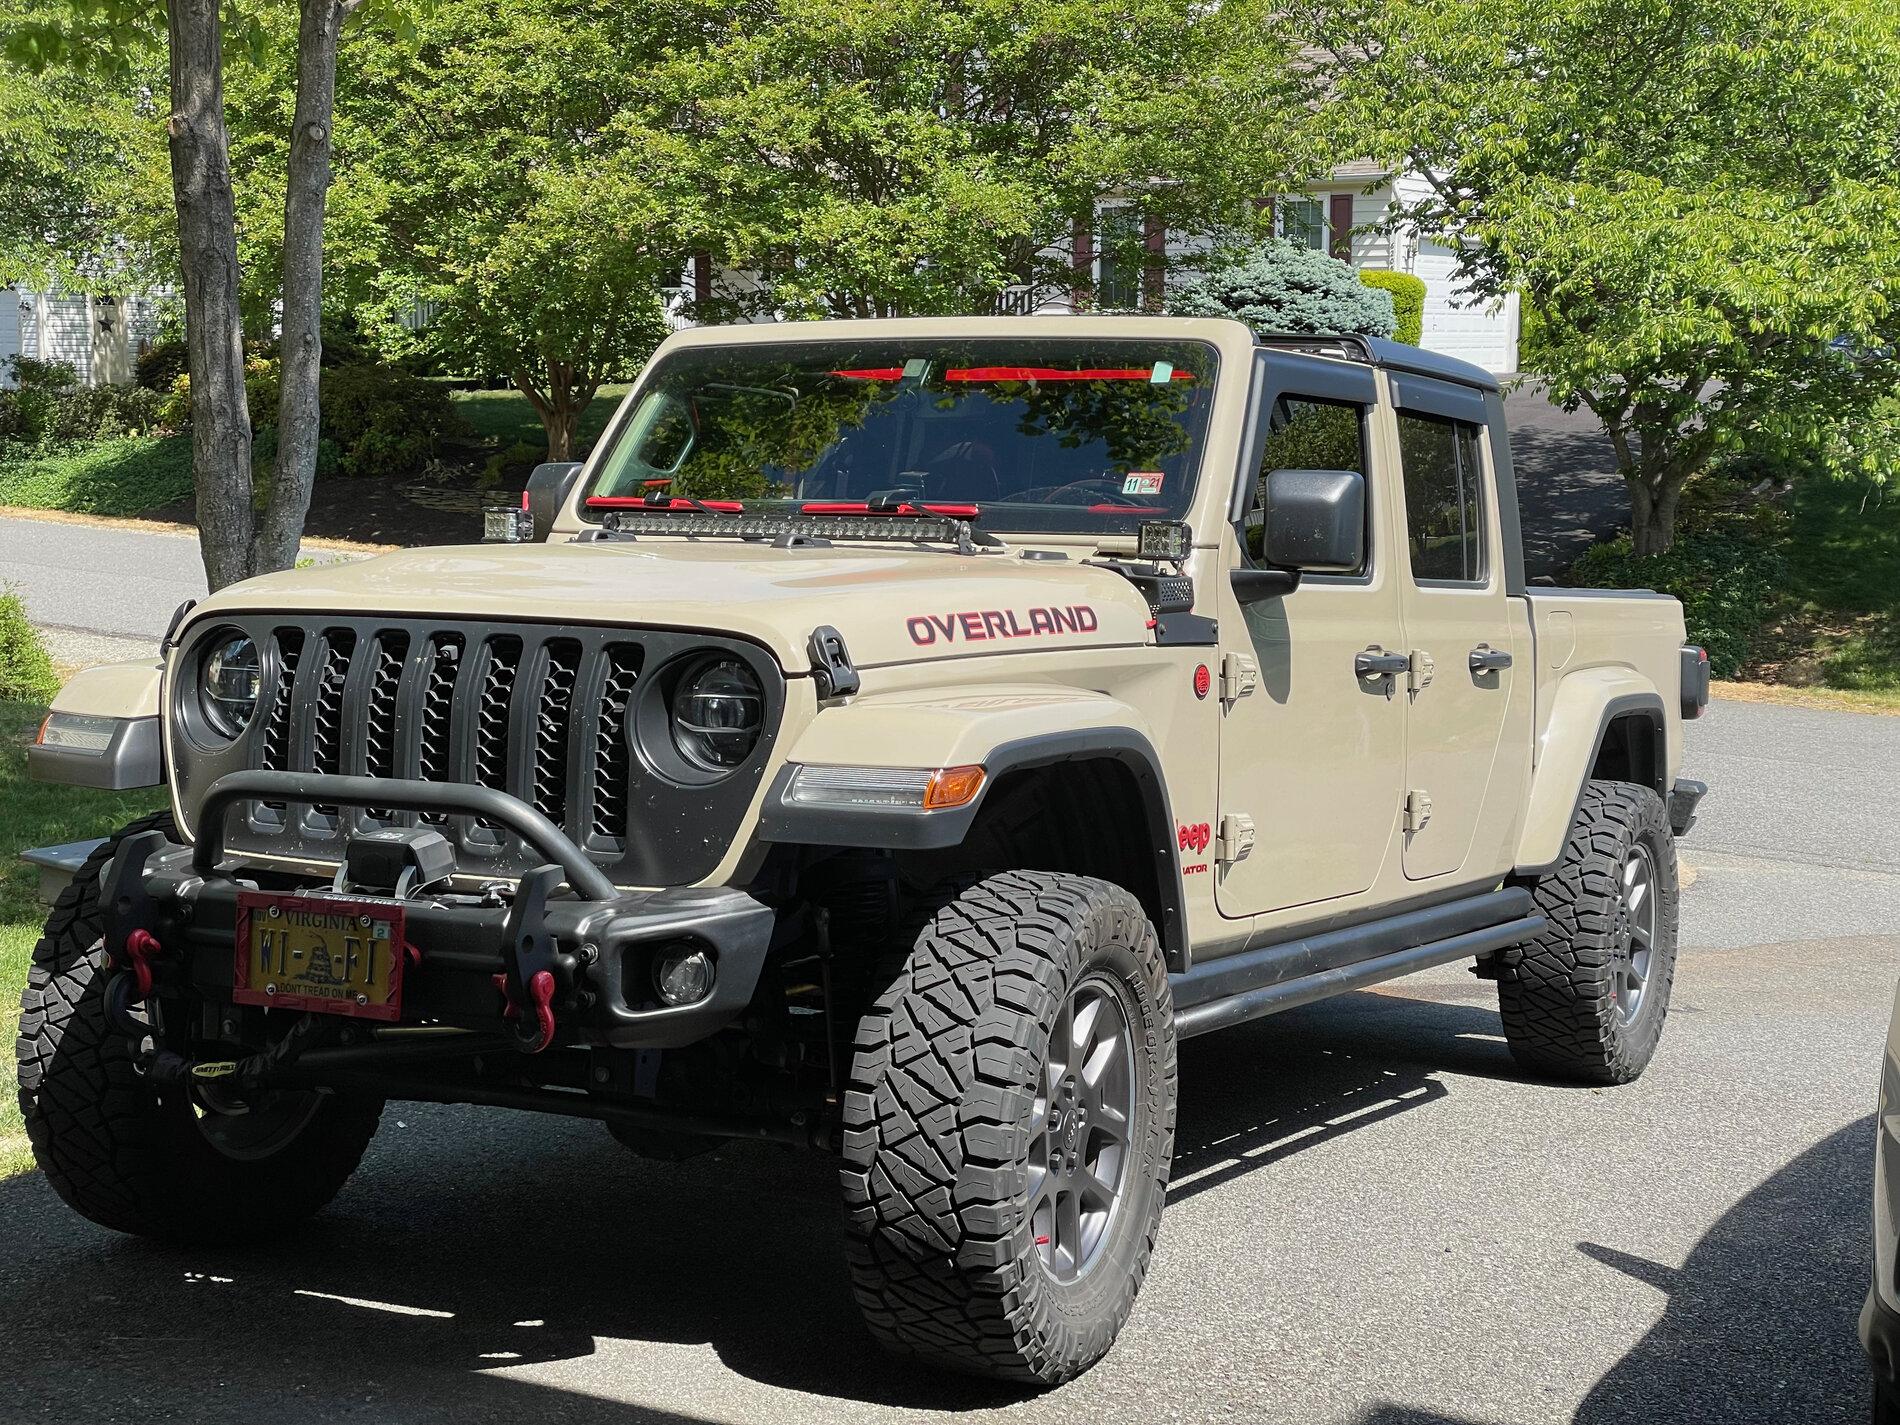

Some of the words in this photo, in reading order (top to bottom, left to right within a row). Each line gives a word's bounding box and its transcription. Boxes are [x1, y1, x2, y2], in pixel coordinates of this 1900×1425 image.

[1127, 478, 1139, 491] 11
[1149, 477, 1161, 488] 21
[906, 605, 1098, 646] OVERLAND
[1178, 822, 1210, 855] eep
[285, 911, 358, 932] VIRGINIA
[304, 984, 330, 997] TREAD
[331, 988, 344, 999] ON
